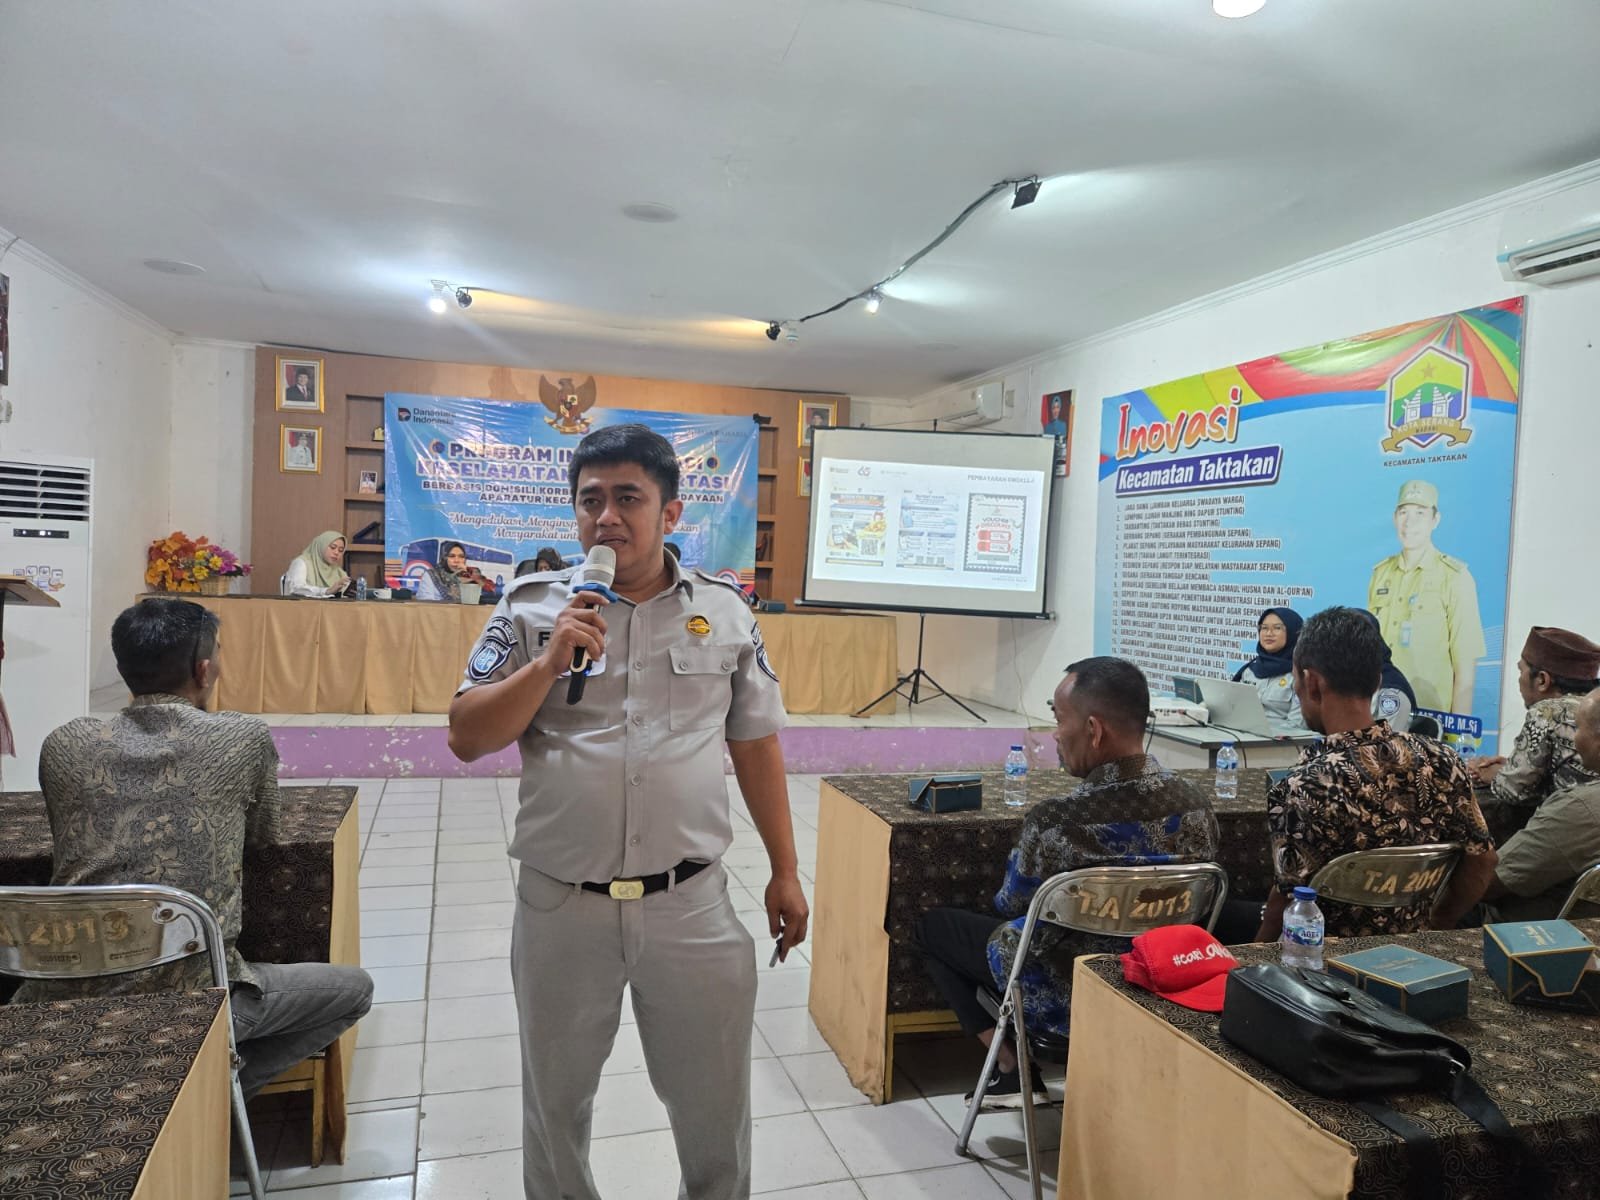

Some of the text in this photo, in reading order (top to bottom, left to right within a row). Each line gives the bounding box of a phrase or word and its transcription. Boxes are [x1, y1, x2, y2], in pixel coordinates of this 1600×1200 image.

[1116, 386, 1240, 461] Inovasi
[1384, 454, 1467, 467] KECAMATAN TAKTAKAN
[1118, 453, 1274, 490] Kecamatan Taktakan
[479, 493, 542, 504] APARATUR
[1223, 496, 1244, 504] WARGA)
[1216, 507, 1244, 515] STUNTING)
[1187, 530, 1226, 538] PEMBANGUNAN
[1227, 529, 1251, 538] SEPANG)
[1222, 540, 1254, 548] KELURAHAN
[1256, 539, 1280, 548] SEPANG)
[1259, 563, 1285, 572] SEPANG)
[1191, 583, 1217, 591] MEMBACA
[1218, 584, 1240, 592] ASMAUL
[1277, 587, 1312, 597] AL-QUR'AN)
[1214, 595, 1252, 603] ADMINISTRASI
[1254, 597, 1271, 605] LEBIH
[1273, 599, 1289, 607] BAIK)
[1191, 604, 1225, 613] MASYARAKAT
[1227, 606, 1241, 614] AGAR
[1173, 614, 1205, 622] MASYARAKAT
[1209, 628, 1232, 636] MELIHAT
[1234, 630, 1257, 639] SAMPAH
[1178, 634, 1193, 642] CEPAT
[1195, 637, 1212, 645] CEGAH
[1213, 639, 1241, 649] STUNTING)
[1206, 649, 1225, 657] WARGA
[1226, 652, 1241, 660] TIDAK
[1079, 889, 1192, 920] T.A 2013
[29, 910, 129, 945] 2013
